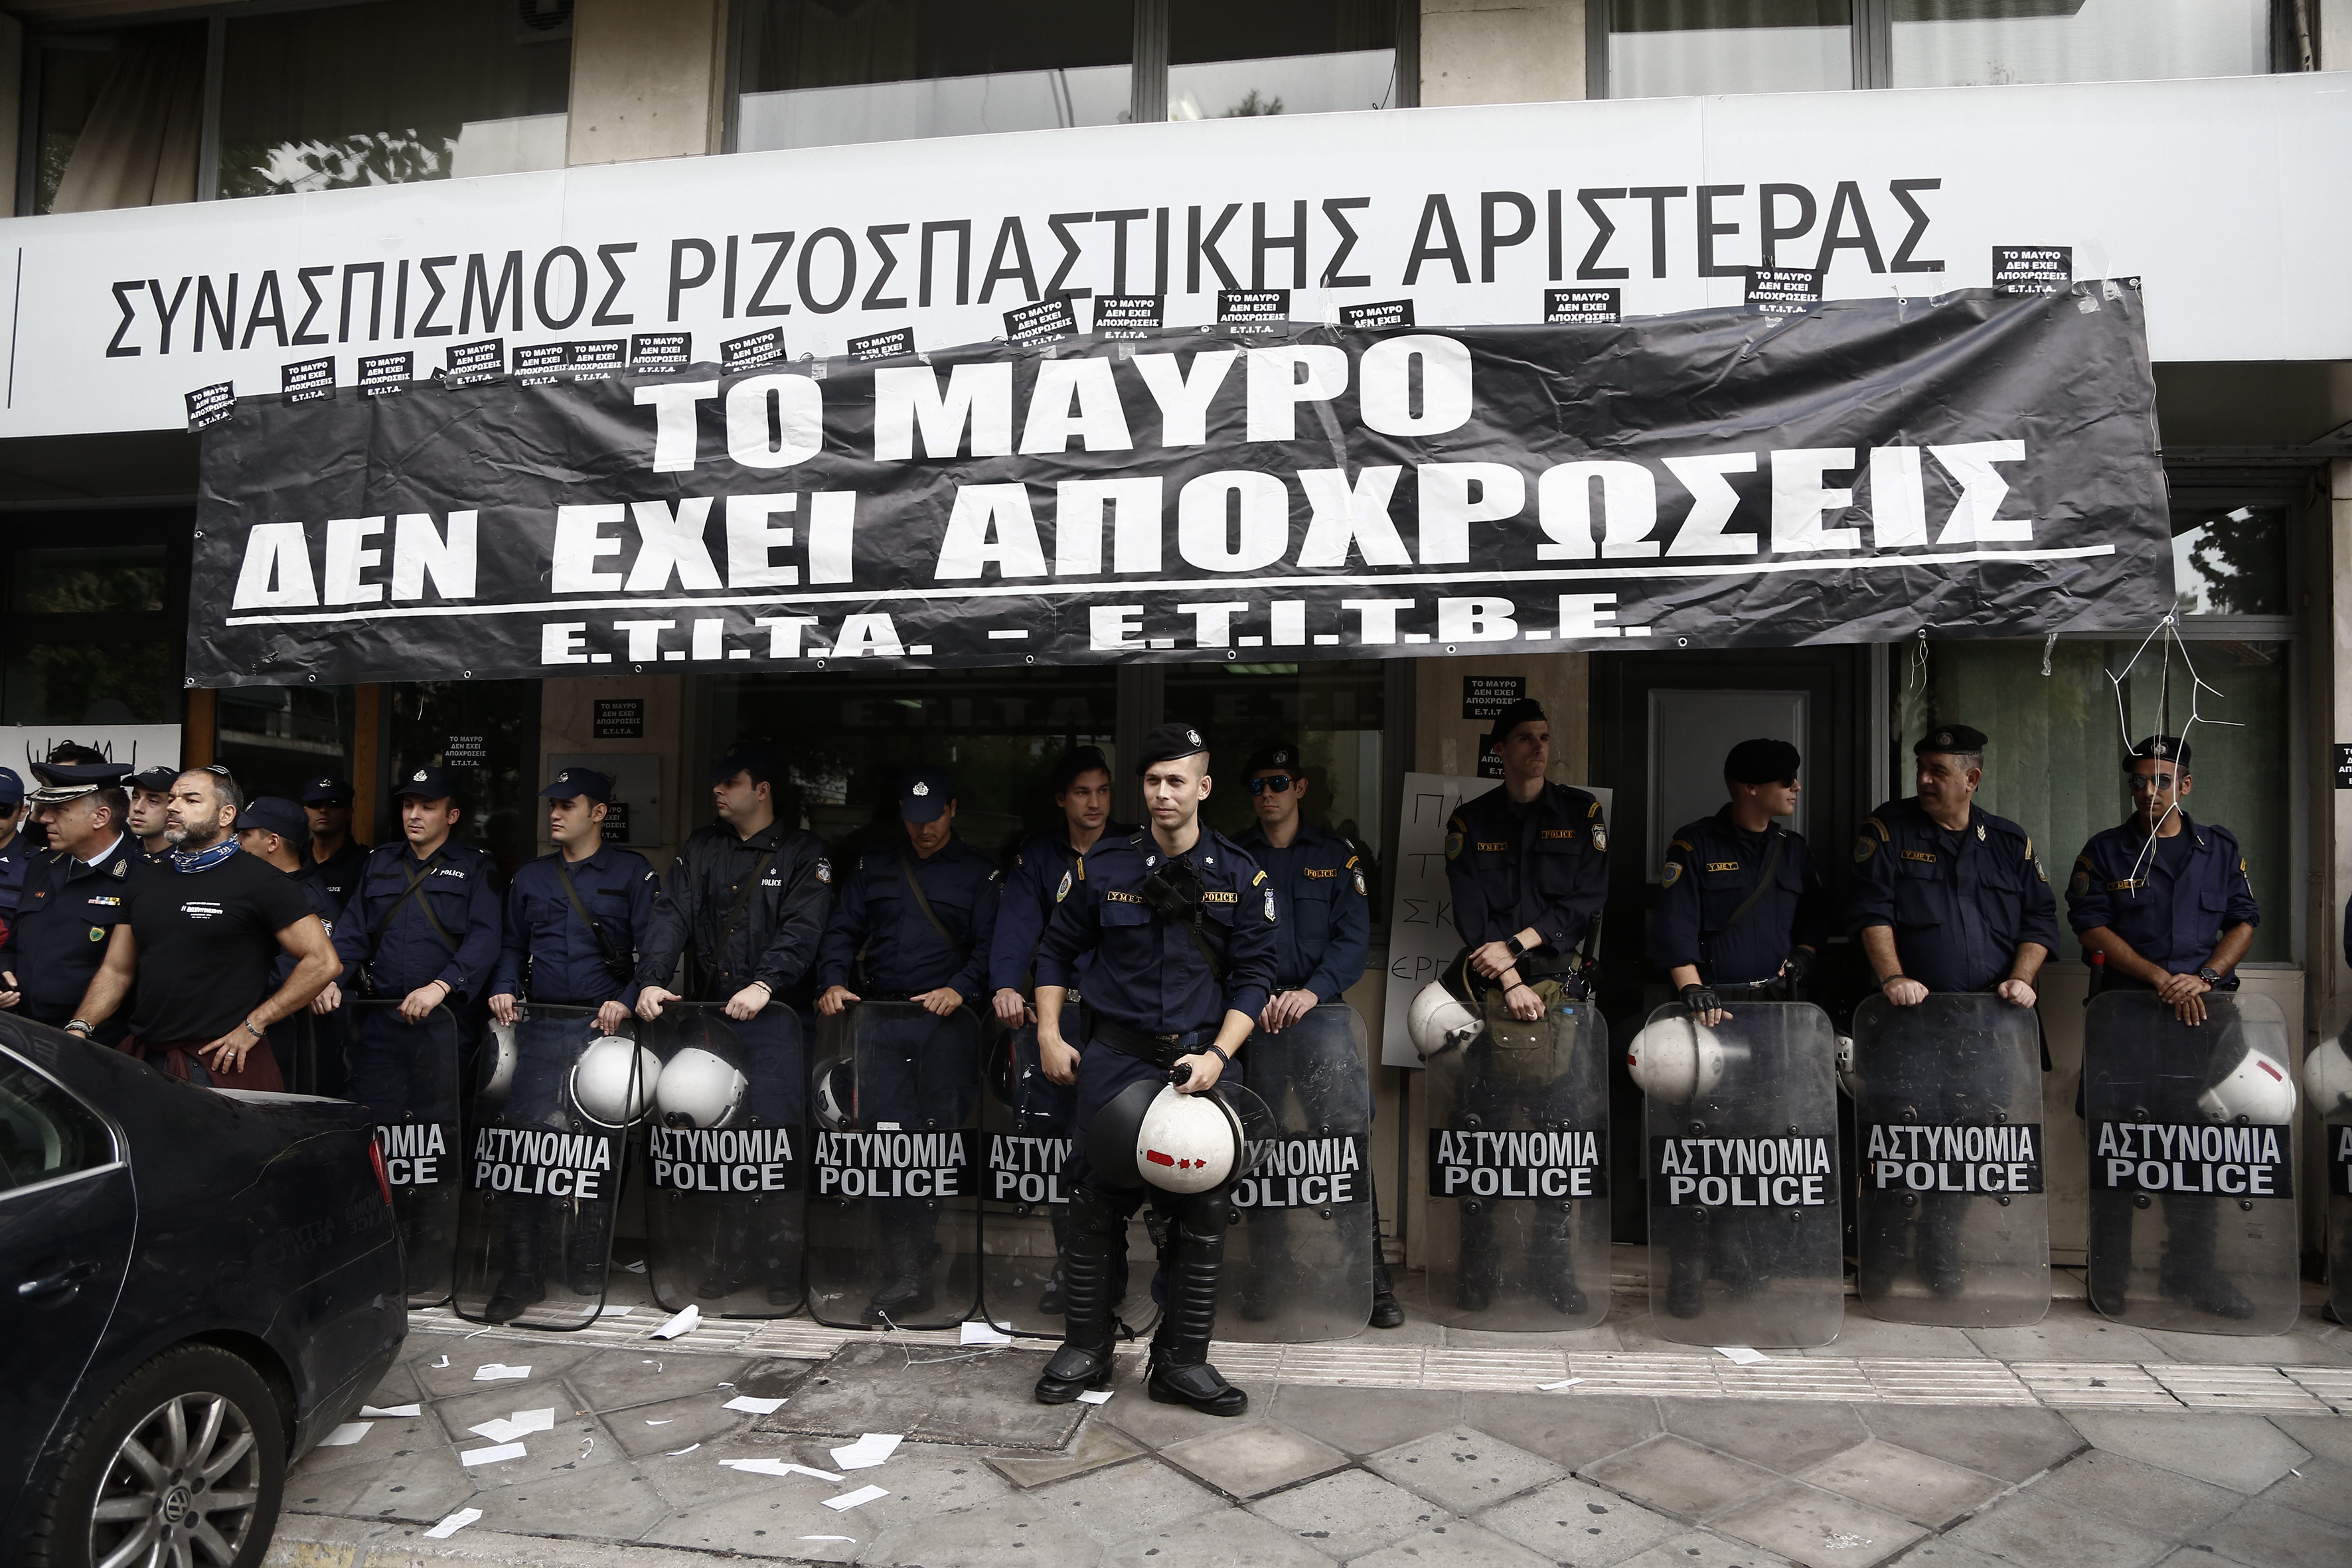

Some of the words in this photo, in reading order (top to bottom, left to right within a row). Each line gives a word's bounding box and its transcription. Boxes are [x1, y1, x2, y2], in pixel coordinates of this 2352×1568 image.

[2003, 251, 2019, 260] ΤΟ
[2021, 251, 2061, 260] ΜΑΥΡΟ
[106, 242, 637, 358] ΣΥΝΑΣΠΙΣΜΟΣ
[668, 197, 1371, 323] ΡΙΖΟΣΠΑΣΤΙΚΗΣ
[1402, 179, 1946, 285] ΑΡΙΣΤΕΡΑΣ
[1756, 271, 1771, 279] ΤΟ
[1774, 272, 1812, 281] ΜΑΥΡΟ
[1996, 272, 2067, 280] ΑΠΟΧΡΩΣΕΙΣ
[1758, 281, 1780, 290] ΔΕΝ
[1784, 283, 1808, 291] ΕΧΕΙ
[2008, 285, 2057, 293] Ε.Τ.Ι.Τ.Α.
[1244, 293, 1280, 302] ΜΑΥΡΟ
[1572, 293, 1610, 301] ΜΑΥΡΟ
[1748, 291, 1818, 302] ΑΠΟΧΡΩΣΕΙΣ
[1012, 312, 1026, 322] ΤΟ
[1028, 301, 1062, 317] ΜΑΥΡΟ
[1349, 310, 1364, 319] ΤΟ
[1366, 305, 1403, 317] ΜΑΥΡΟ
[1582, 303, 1607, 311] ΕΧΕΙ
[1759, 305, 1807, 313] Ε.Τ.Ι.Τ.Α.
[1018, 319, 1038, 331] ΔΕΝ
[1040, 311, 1061, 324] ΕΧΕΙ
[1220, 313, 1285, 322] ΑΠΟΧΡΩΣΕΙΣ
[1379, 315, 1401, 326] ΕΧΕΙ
[1548, 313, 1616, 322] ΑΠΟΧΡΩΣΕΙΣ
[1011, 317, 1073, 341] ΑΠΟΧΡΩΣΕΙΣ
[728, 343, 742, 352] ΤΟ
[743, 333, 775, 347] ΜΑΥΡΟ
[856, 341, 870, 350] ΤΟ
[872, 333, 904, 347] ΜΑΥΡΟ
[1022, 333, 1065, 348] Ε.Τ.Ι.Τ.Α.
[467, 343, 496, 354] ΜΑΥΡΟ
[534, 347, 563, 356] ΜΑΥΡΟ
[588, 344, 618, 353] ΜΑΥΡΟ
[732, 351, 751, 360] ΔΕΝ
[753, 343, 773, 355] ΕΧΕΙ
[882, 343, 903, 354] ΕΧΕΙ
[378, 356, 406, 366] ΜΑΥΡΟ
[456, 357, 473, 366] ΔΕΝ
[475, 353, 493, 362] ΕΧΕΙ
[541, 356, 560, 364] ΕΧΕΙ
[632, 355, 687, 364] ΑΠΟΧΡΩΣΕΙΣ
[301, 361, 328, 372] ΜΑΥΡΟ
[386, 365, 403, 374] ΕΧΕΙ
[449, 360, 501, 375] ΑΠΟΧΡΩΣΕΙΣ
[514, 364, 567, 376] ΑΠΟΧΡΩΣΕΙΣ
[568, 361, 622, 371] ΑΠΟΧΡΩΣΕΙΣ
[309, 370, 326, 380] ΕΧΕΙ
[360, 373, 410, 386] ΑΠΟΧΡΩΣΕΙΣ
[457, 373, 493, 385] Ε.Τ.Ι.Τ.Α.
[522, 376, 558, 386] Ε.Τ.Ι.Τ.Α.
[575, 372, 611, 381] Ε.Τ.Ι.Τ.Α.
[284, 377, 333, 393] ΑΠΟΧΡΩΣΕΙΣ
[368, 385, 401, 396] Ε.Τ.Ι.Τ.Α.
[192, 393, 202, 402] ΤΟ
[292, 390, 325, 402] Ε.Τ.Ι.Τ.Α.
[195, 400, 209, 410] ΔΕΝ
[634, 374, 823, 473] ΤΟ
[874, 335, 1473, 461] ΜΑΥΡΟ
[231, 510, 479, 611] ΔΕΝ
[551, 490, 856, 593] ΕΧΕΙ
[933, 439, 2033, 580] ΑΠΟΧΡΩΣΕΙΣ
[540, 613, 933, 664] Ε.Τ.Ι.Τ.Α.
[1089, 593, 1652, 650] Ε.Τ.Ι.Τ.Β.Ε.
[439, 869, 465, 879] POLICE
[1202, 893, 1234, 902] POLICE
[650, 1125, 793, 1162] ΑΣΤΥΝΟΜΙΑ
[1437, 1130, 1599, 1167] ΑΣΤΥΝΟΜΙΑ
[1867, 1125, 2034, 1162] ΑΣΤΥΝΟΜΙΑ
[2097, 1122, 2282, 1164] ΑΣΤΥΝΟΜΙΑ
[474, 1128, 611, 1171] ΑΣΤΥΝΟΜΙΑ
[815, 1131, 967, 1168] ΑΣΤΥΝΟΜΙΑ
[1661, 1138, 1831, 1174] ΑΣΤΥΝΟΜΙΑ
[475, 1162, 601, 1199] POLICE
[655, 1158, 785, 1192] POLICE
[1445, 1166, 1593, 1196] POLICE
[1877, 1160, 2029, 1192] POLICE
[2108, 1158, 2274, 1194] POLICE
[821, 1166, 959, 1197] POLICE
[996, 1171, 1069, 1204] POL
[1230, 1172, 1353, 1208] OLICE
[1670, 1176, 1825, 1206] POLICE
